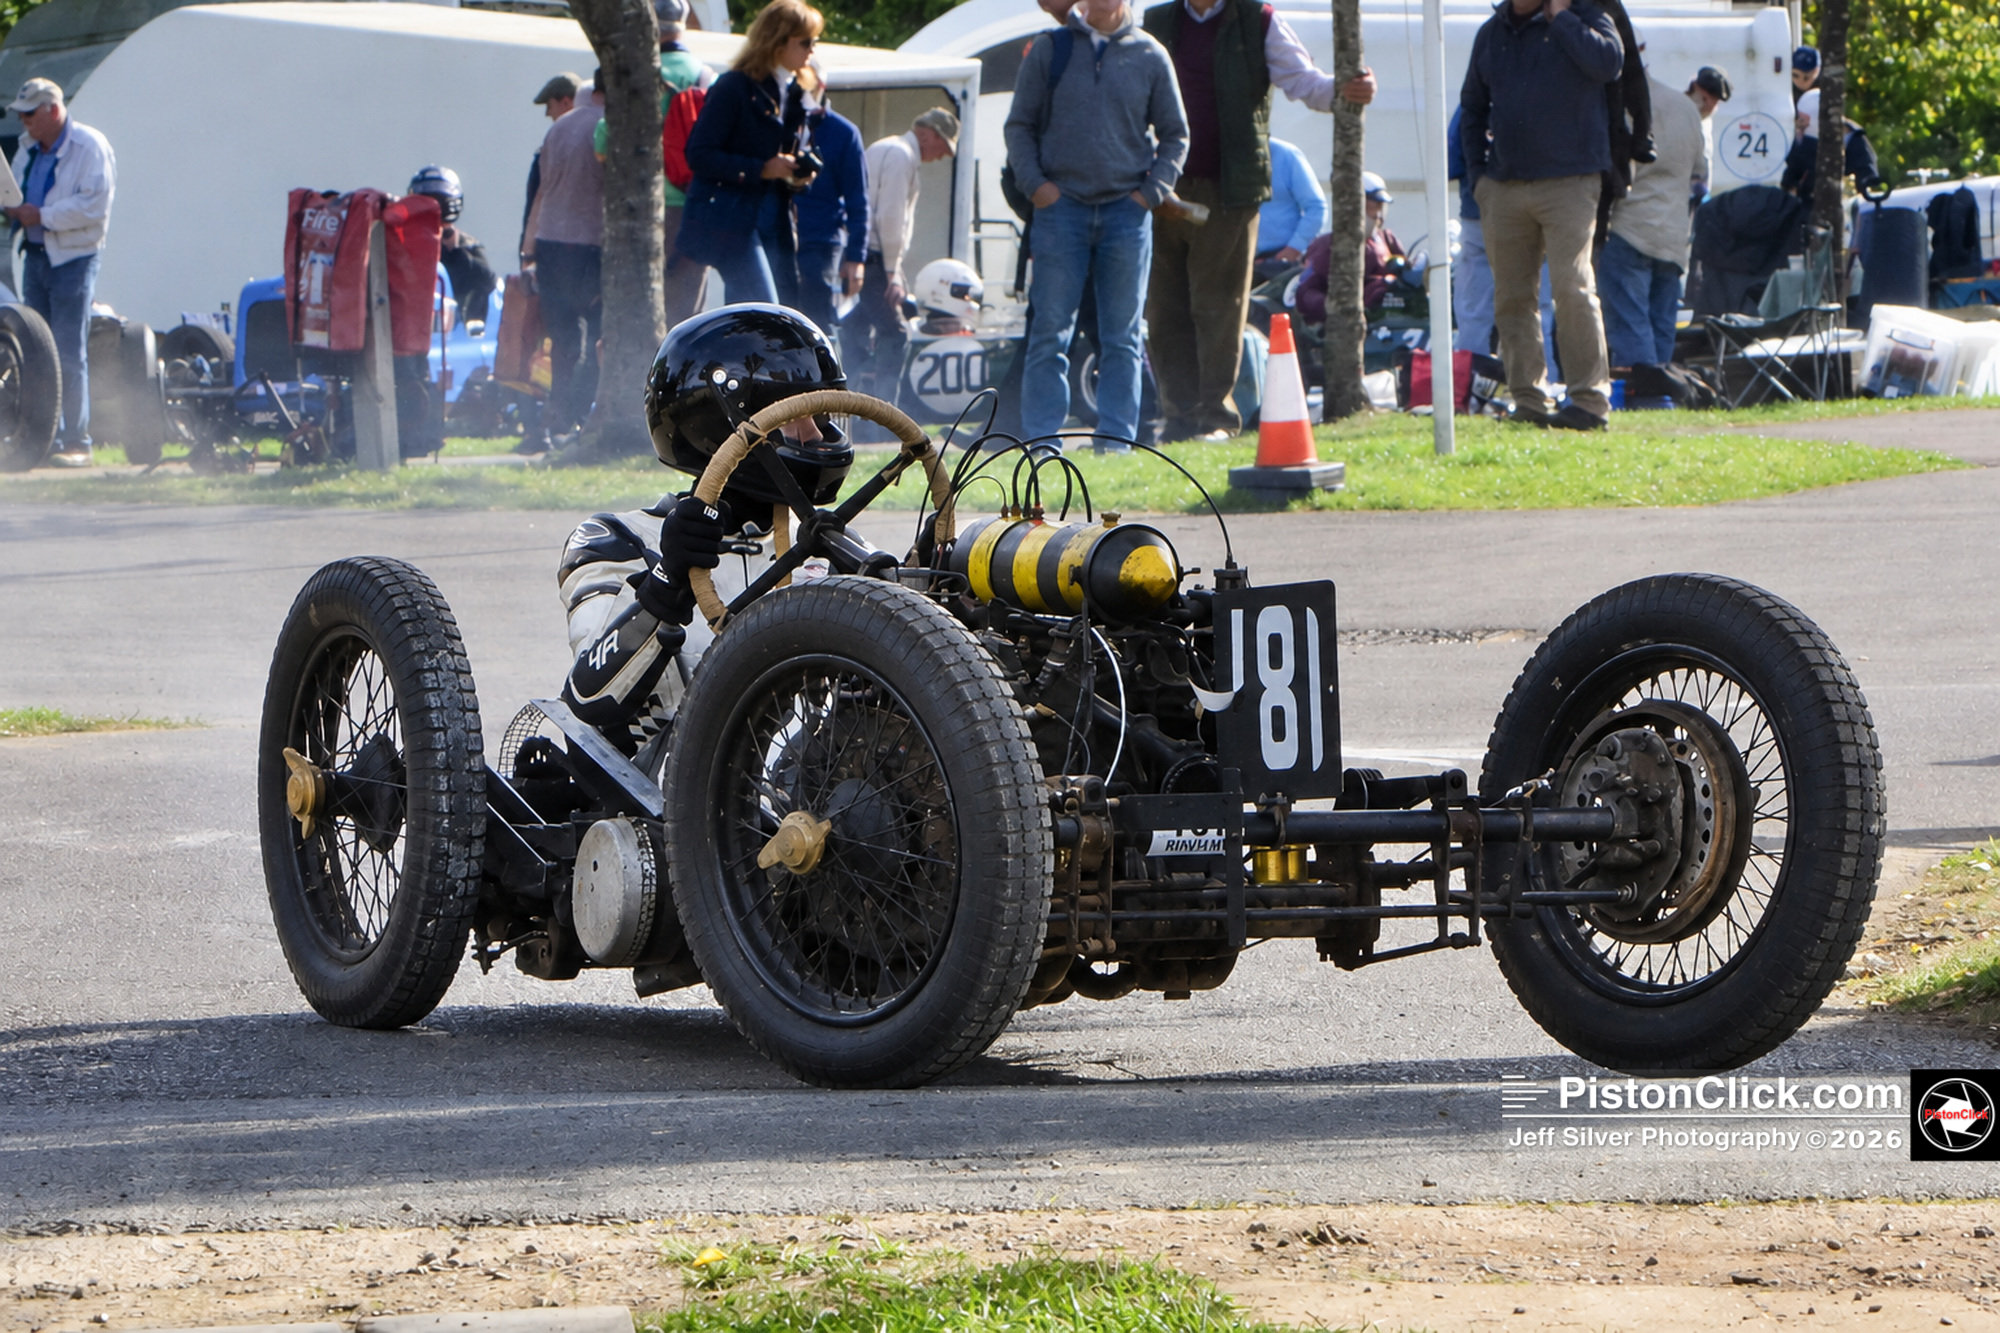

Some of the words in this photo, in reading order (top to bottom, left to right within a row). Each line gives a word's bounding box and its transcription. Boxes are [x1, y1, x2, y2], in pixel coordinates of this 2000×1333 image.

[1738, 132, 1769, 158] 24
[302, 207, 339, 232] Fire
[917, 350, 987, 395] 200
